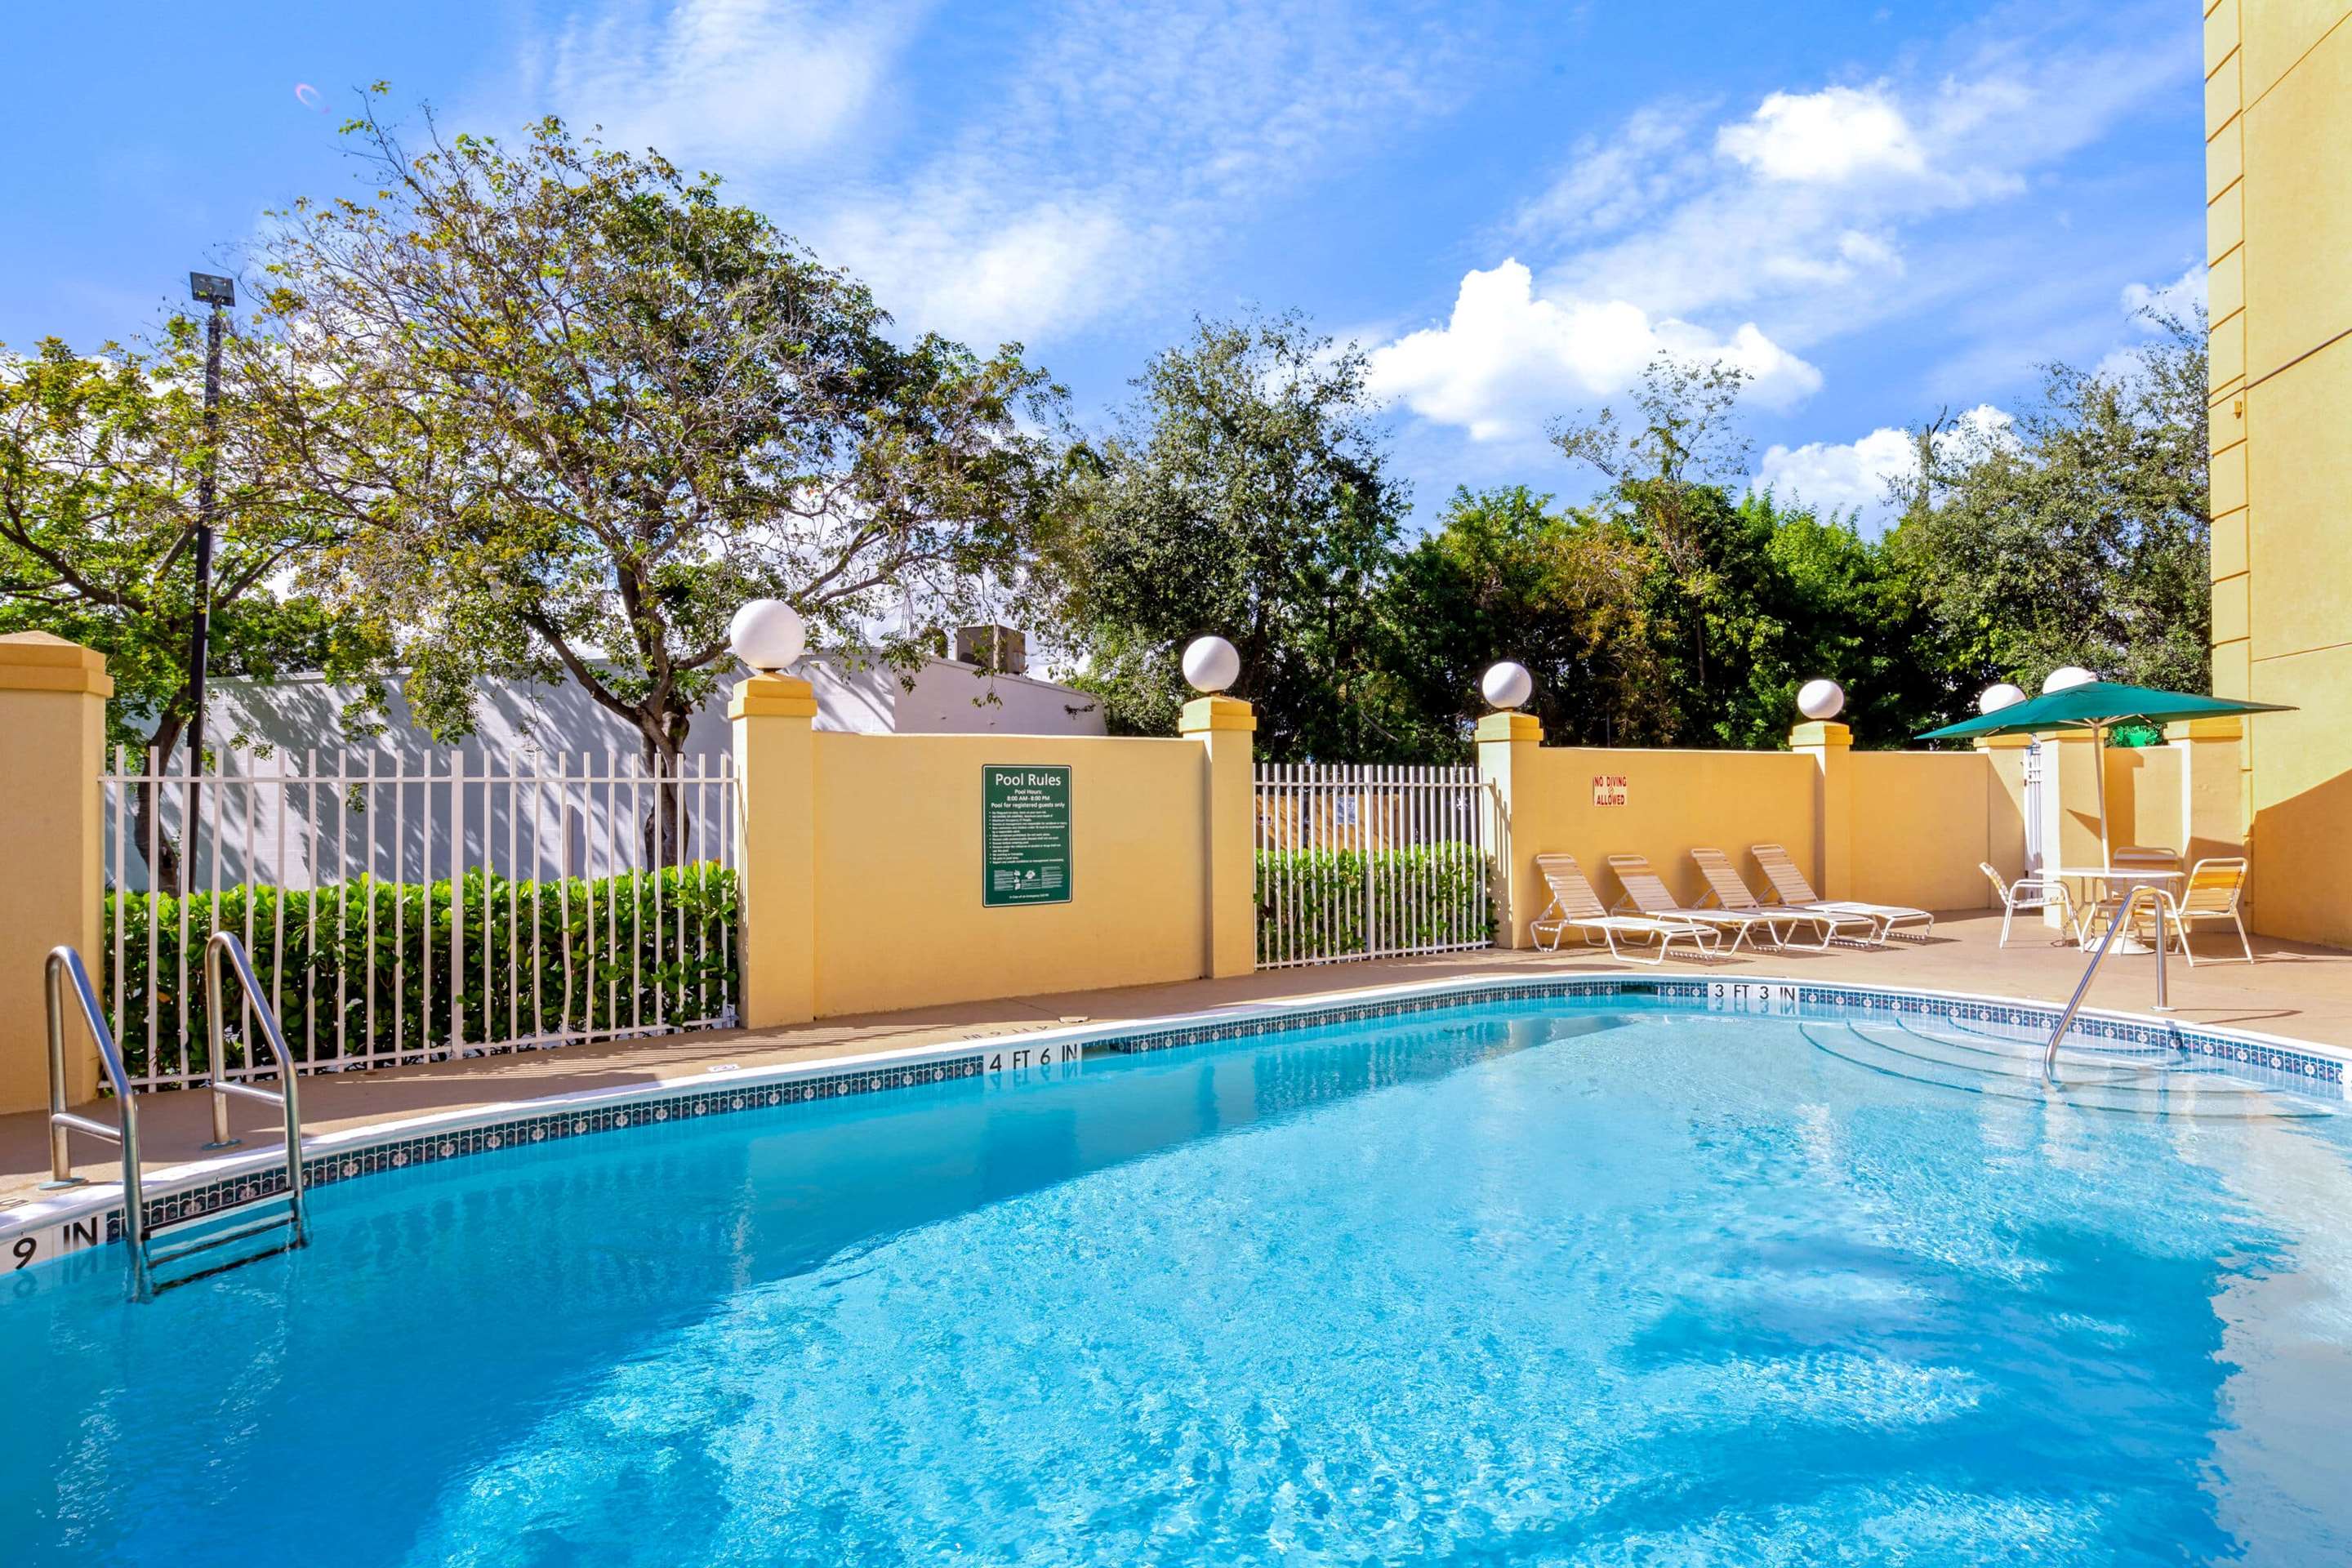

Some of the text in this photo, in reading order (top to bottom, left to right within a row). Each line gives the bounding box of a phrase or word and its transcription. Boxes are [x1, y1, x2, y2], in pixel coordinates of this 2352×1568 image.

[995, 773, 1062, 786] Pool Rules
[1594, 776, 1627, 786] NO DIVING
[1597, 794, 1625, 805] ALLOWED
[1714, 984, 1795, 1001] 3 FT 3 IN
[989, 1043, 1077, 1072] 4 FT 6 IN
[12, 1236, 38, 1271] 9
[63, 1216, 98, 1253] IN
